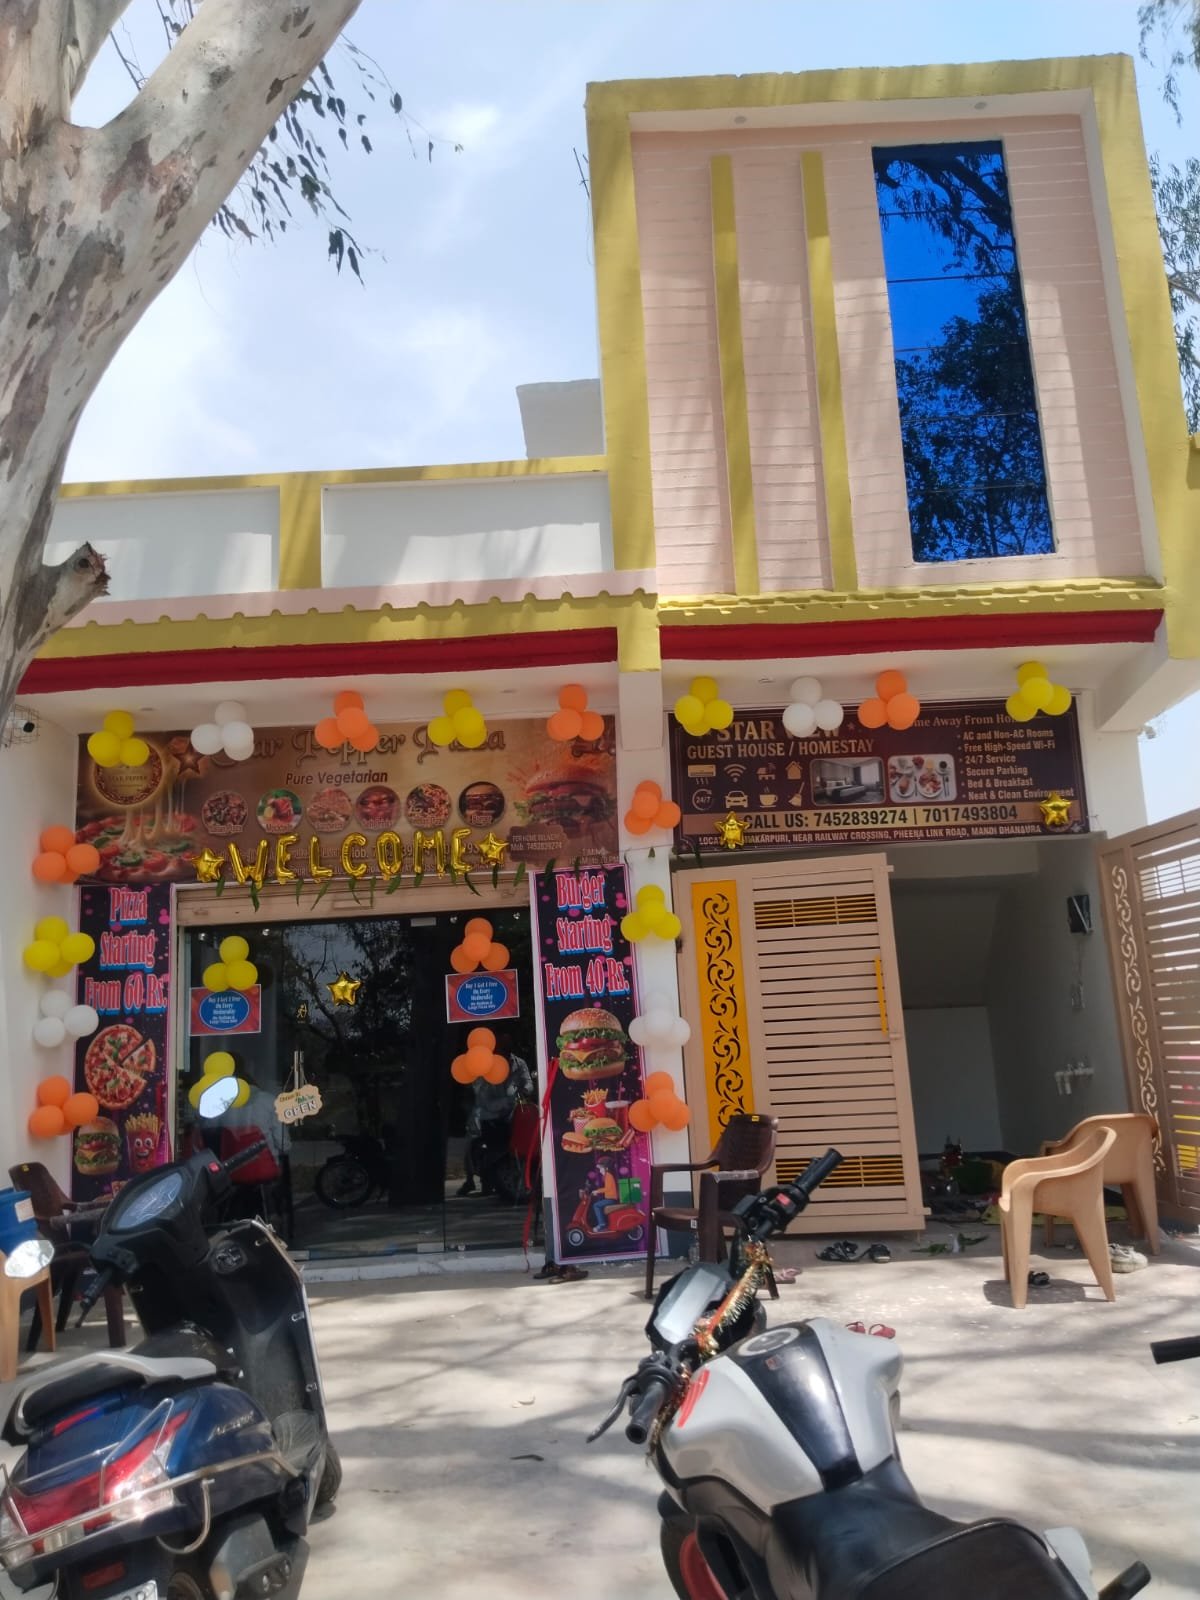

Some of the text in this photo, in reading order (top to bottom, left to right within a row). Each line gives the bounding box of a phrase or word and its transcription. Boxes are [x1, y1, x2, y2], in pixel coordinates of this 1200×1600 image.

[933, 716, 962, 728] Away
[964, 714, 994, 725] From
[963, 729, 1054, 741] AC and Non-AC Rooms
[687, 739, 875, 760] GUEST HOUSE / HOMESTAY
[964, 743, 984, 752] Free
[985, 741, 1031, 753] High-Speed
[965, 754, 1017, 765] 24/7 Service
[285, 770, 388, 787] Pure Vegetarian
[966, 765, 1028, 776] Secure Parking
[967, 779, 983, 788] Bed
[994, 777, 1033, 787] Breakfast
[968, 791, 987, 800] Neat
[998, 789, 1021, 799] Clean
[1023, 788, 1075, 798] Enviroent
[743, 812, 783, 829] CALL
[785, 812, 809, 828] US:
[814, 809, 908, 827] 7452839274
[923, 805, 1018, 823] 7017493804
[815, 832, 849, 842] RAILWAY
[926, 829, 944, 838] LINK
[228, 828, 472, 888] WELCOME
[555, 872, 606, 910] Burger
[110, 886, 148, 924] Pizza
[555, 914, 613, 953] Starting
[100, 929, 155, 970] Starting
[545, 957, 630, 999] From 40 Rs.
[85, 973, 168, 1013] From 60 Rs.
[284, 1100, 317, 1119] OPEN
